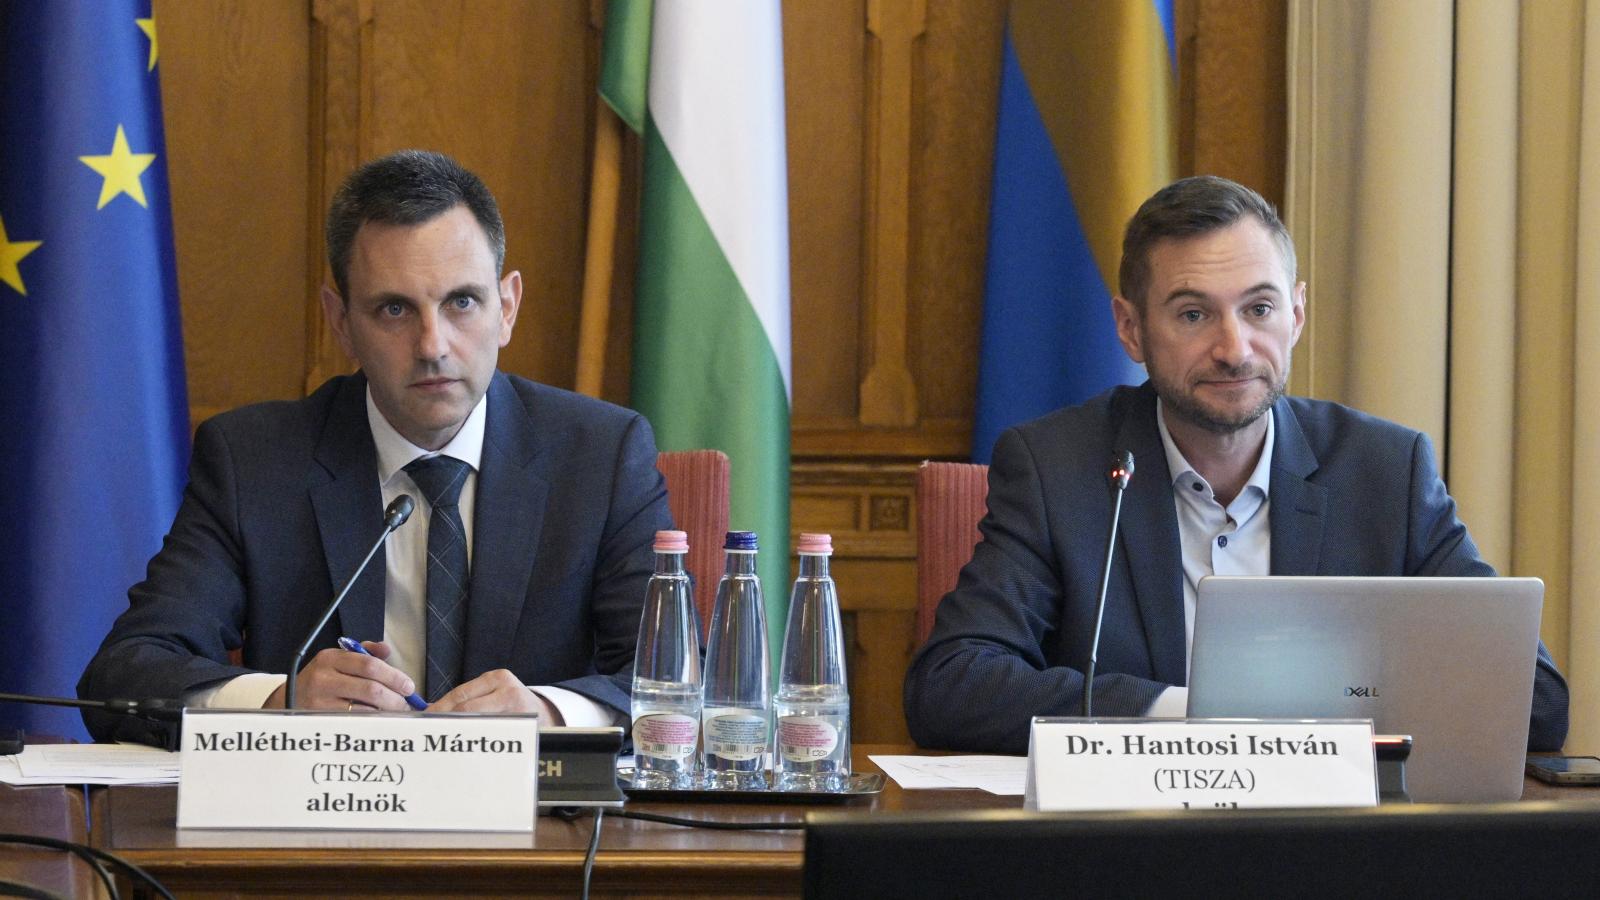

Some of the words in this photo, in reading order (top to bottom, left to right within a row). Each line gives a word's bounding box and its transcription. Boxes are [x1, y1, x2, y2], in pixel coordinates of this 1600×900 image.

[1343, 686, 1380, 698] DELL
[193, 731, 415, 753] Melléthei-Barna
[422, 731, 524, 754] Márton
[1065, 734, 1112, 756] Dr.
[1121, 733, 1239, 756] Hantosi
[1247, 735, 1339, 756] István
[310, 762, 405, 785] (TISZA)
[1153, 768, 1256, 793] (TISZA)
[306, 792, 407, 812] alelnök
